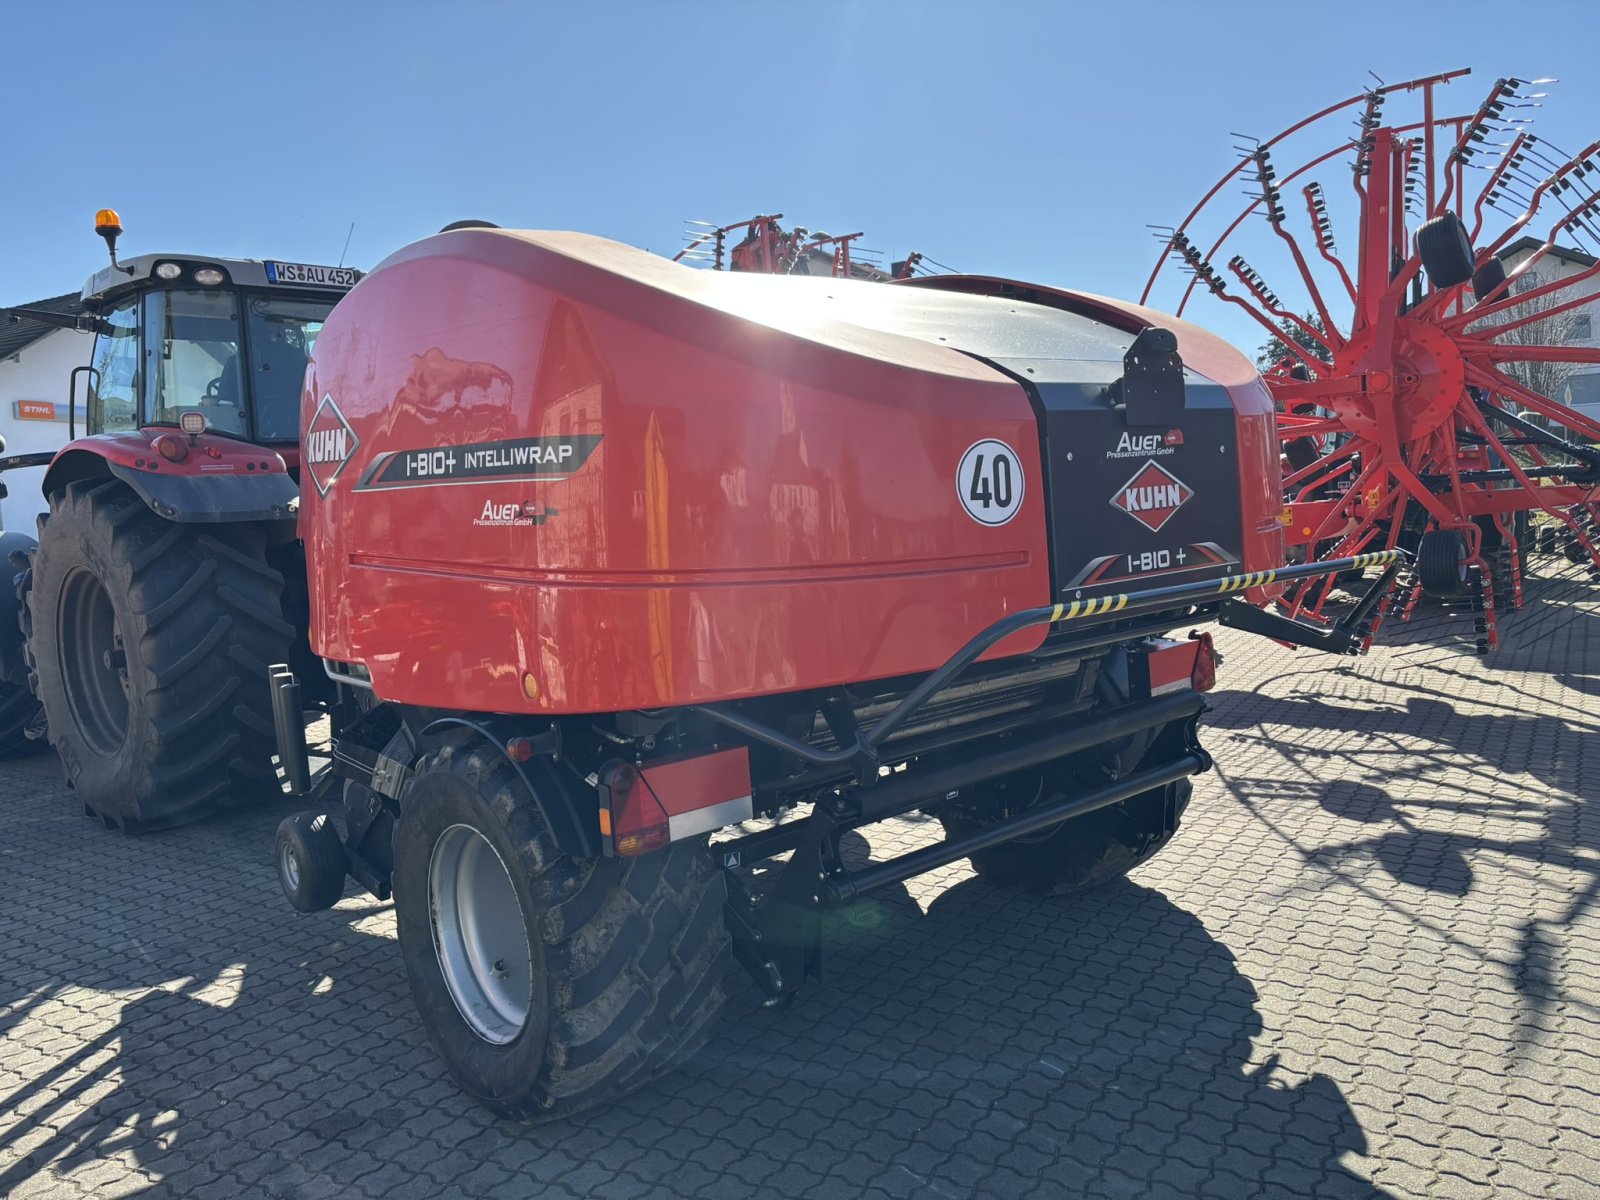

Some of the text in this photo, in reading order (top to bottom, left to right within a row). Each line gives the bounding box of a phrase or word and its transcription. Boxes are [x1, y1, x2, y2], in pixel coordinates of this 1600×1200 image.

[276, 264, 354, 286] WS AU 452
[23, 405, 51, 414] STIHL
[308, 428, 347, 463] KUHN
[1106, 446, 1175, 459] Pressenzentrum GmbH
[406, 445, 573, 477] I-BIO+ INTELLIWRAP
[970, 453, 1012, 509] 40
[1125, 483, 1181, 512] KUHN
[514, 518, 533, 526] GmbH
[1127, 549, 1170, 573] I-BIO
